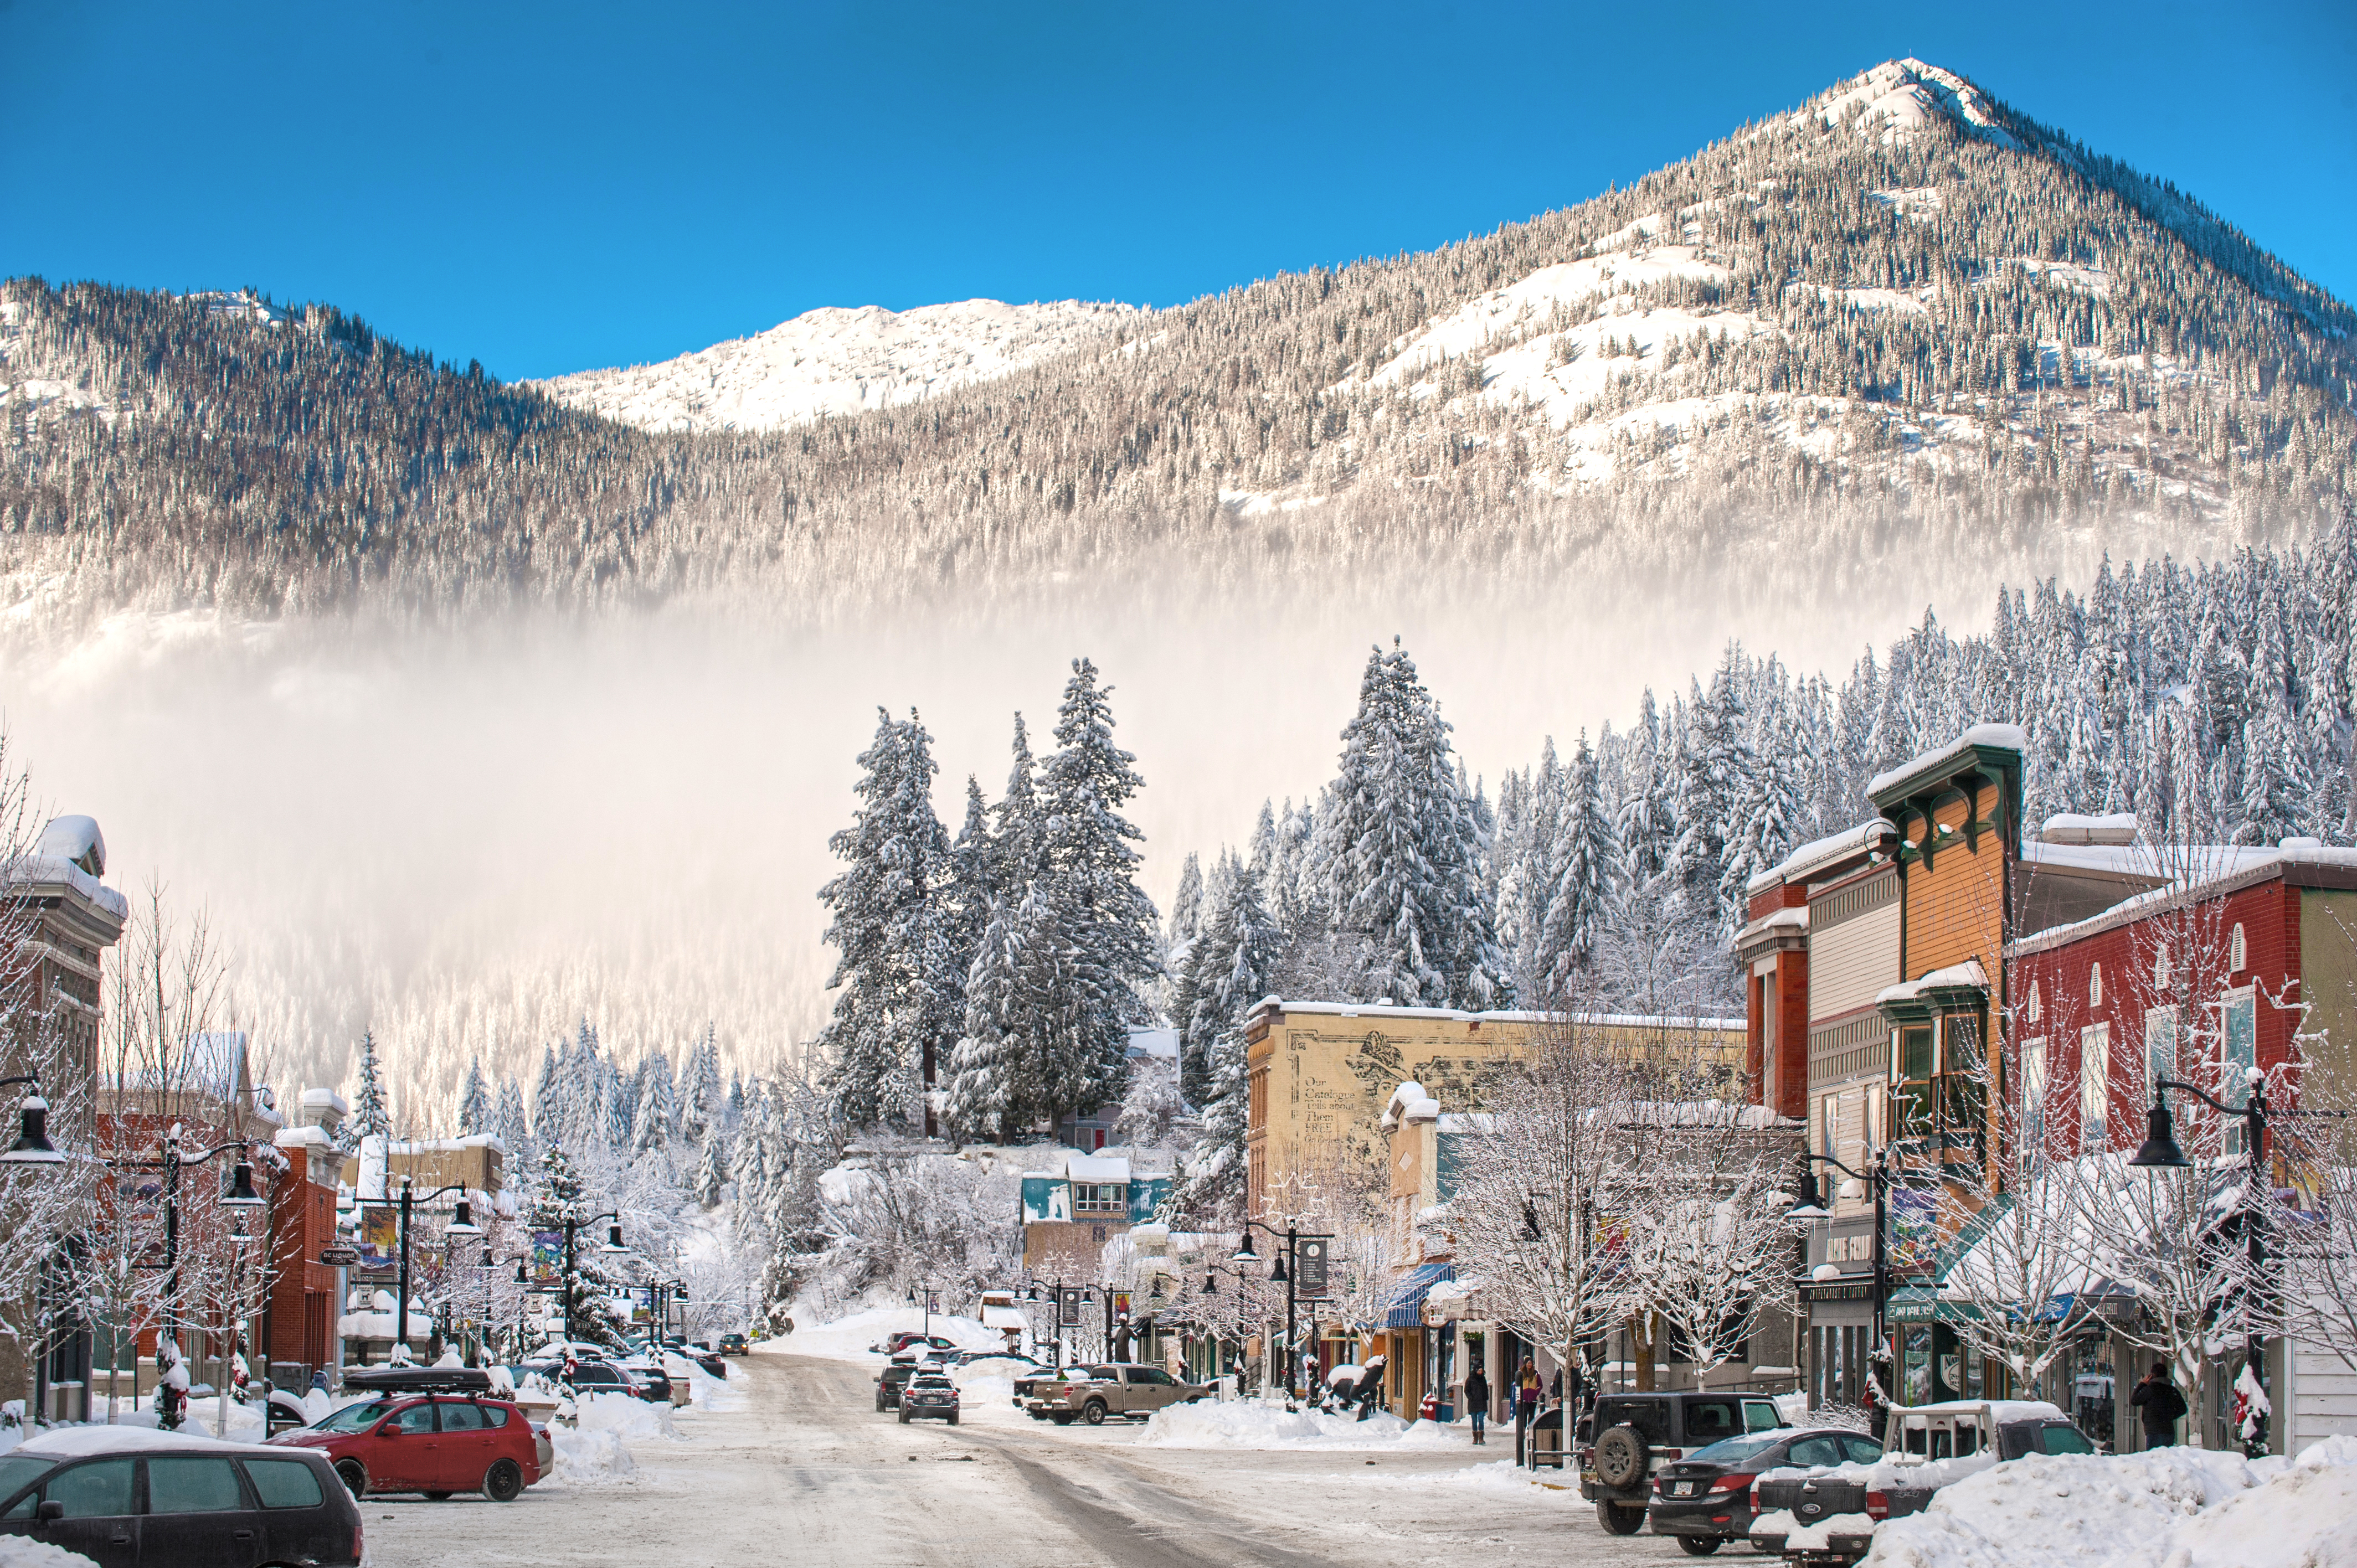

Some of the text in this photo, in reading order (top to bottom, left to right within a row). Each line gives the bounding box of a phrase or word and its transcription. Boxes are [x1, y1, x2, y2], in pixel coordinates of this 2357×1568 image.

[1305, 1076, 1326, 1086] Our
[1305, 1089, 1355, 1102] Catalogue
[1305, 1100, 1355, 1110] Tells about
[1305, 1111, 1333, 1121] Them
[1305, 1123, 1332, 1133] FREE
